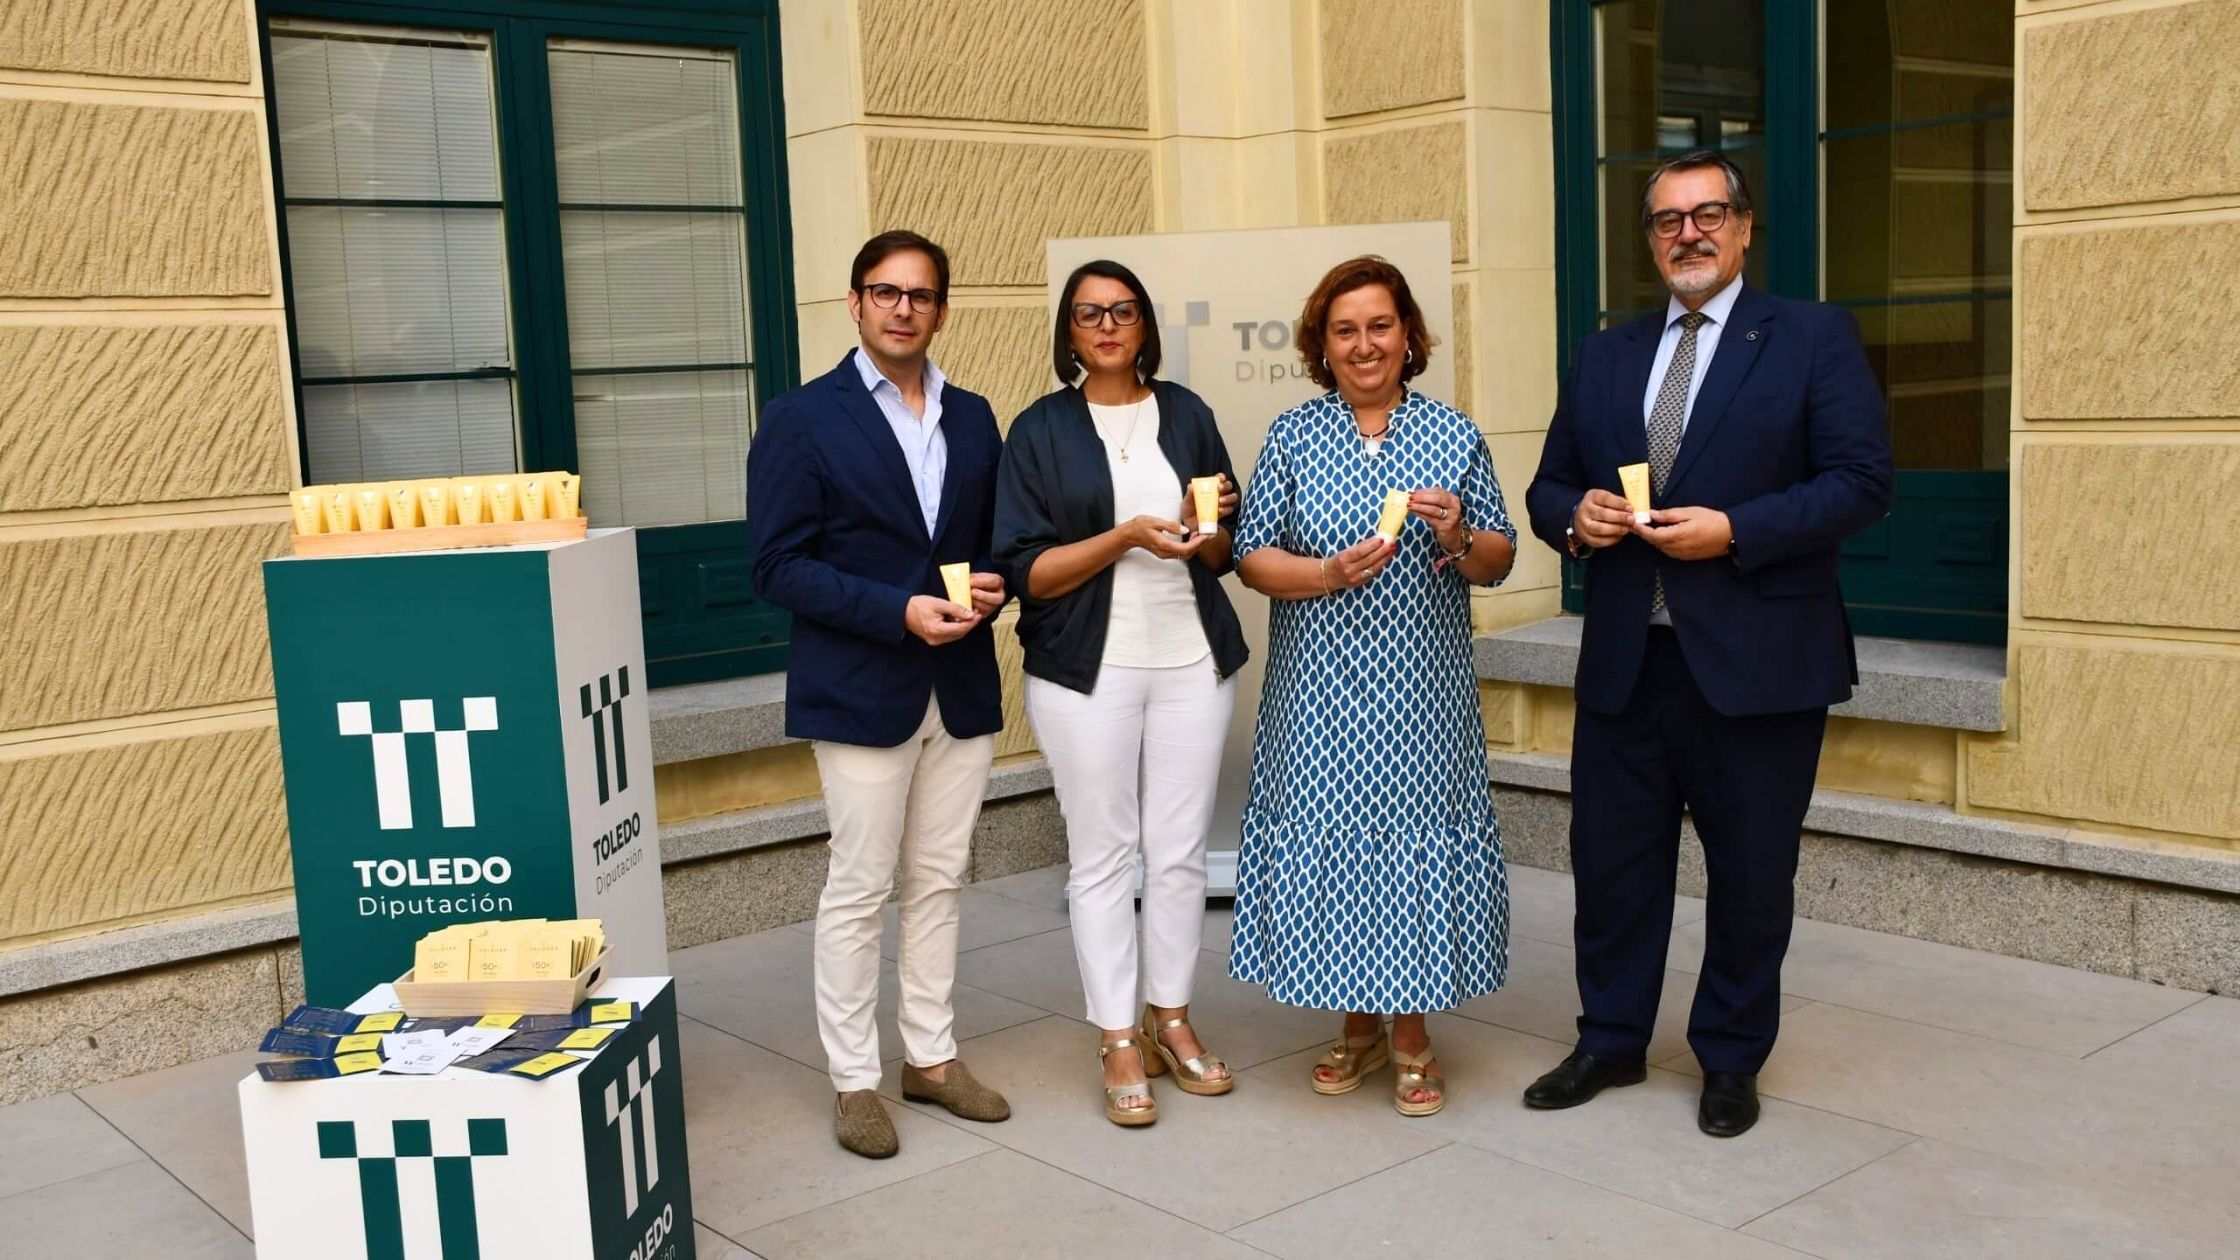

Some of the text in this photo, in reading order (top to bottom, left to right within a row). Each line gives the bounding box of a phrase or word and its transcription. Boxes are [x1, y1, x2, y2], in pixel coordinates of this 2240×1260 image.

[593, 811, 641, 867] TOLEDO
[352, 856, 512, 888] TOLEDO
[596, 847, 643, 895] Diputación
[358, 893, 513, 919] Diputación
[628, 1203, 673, 1260] LEDO
